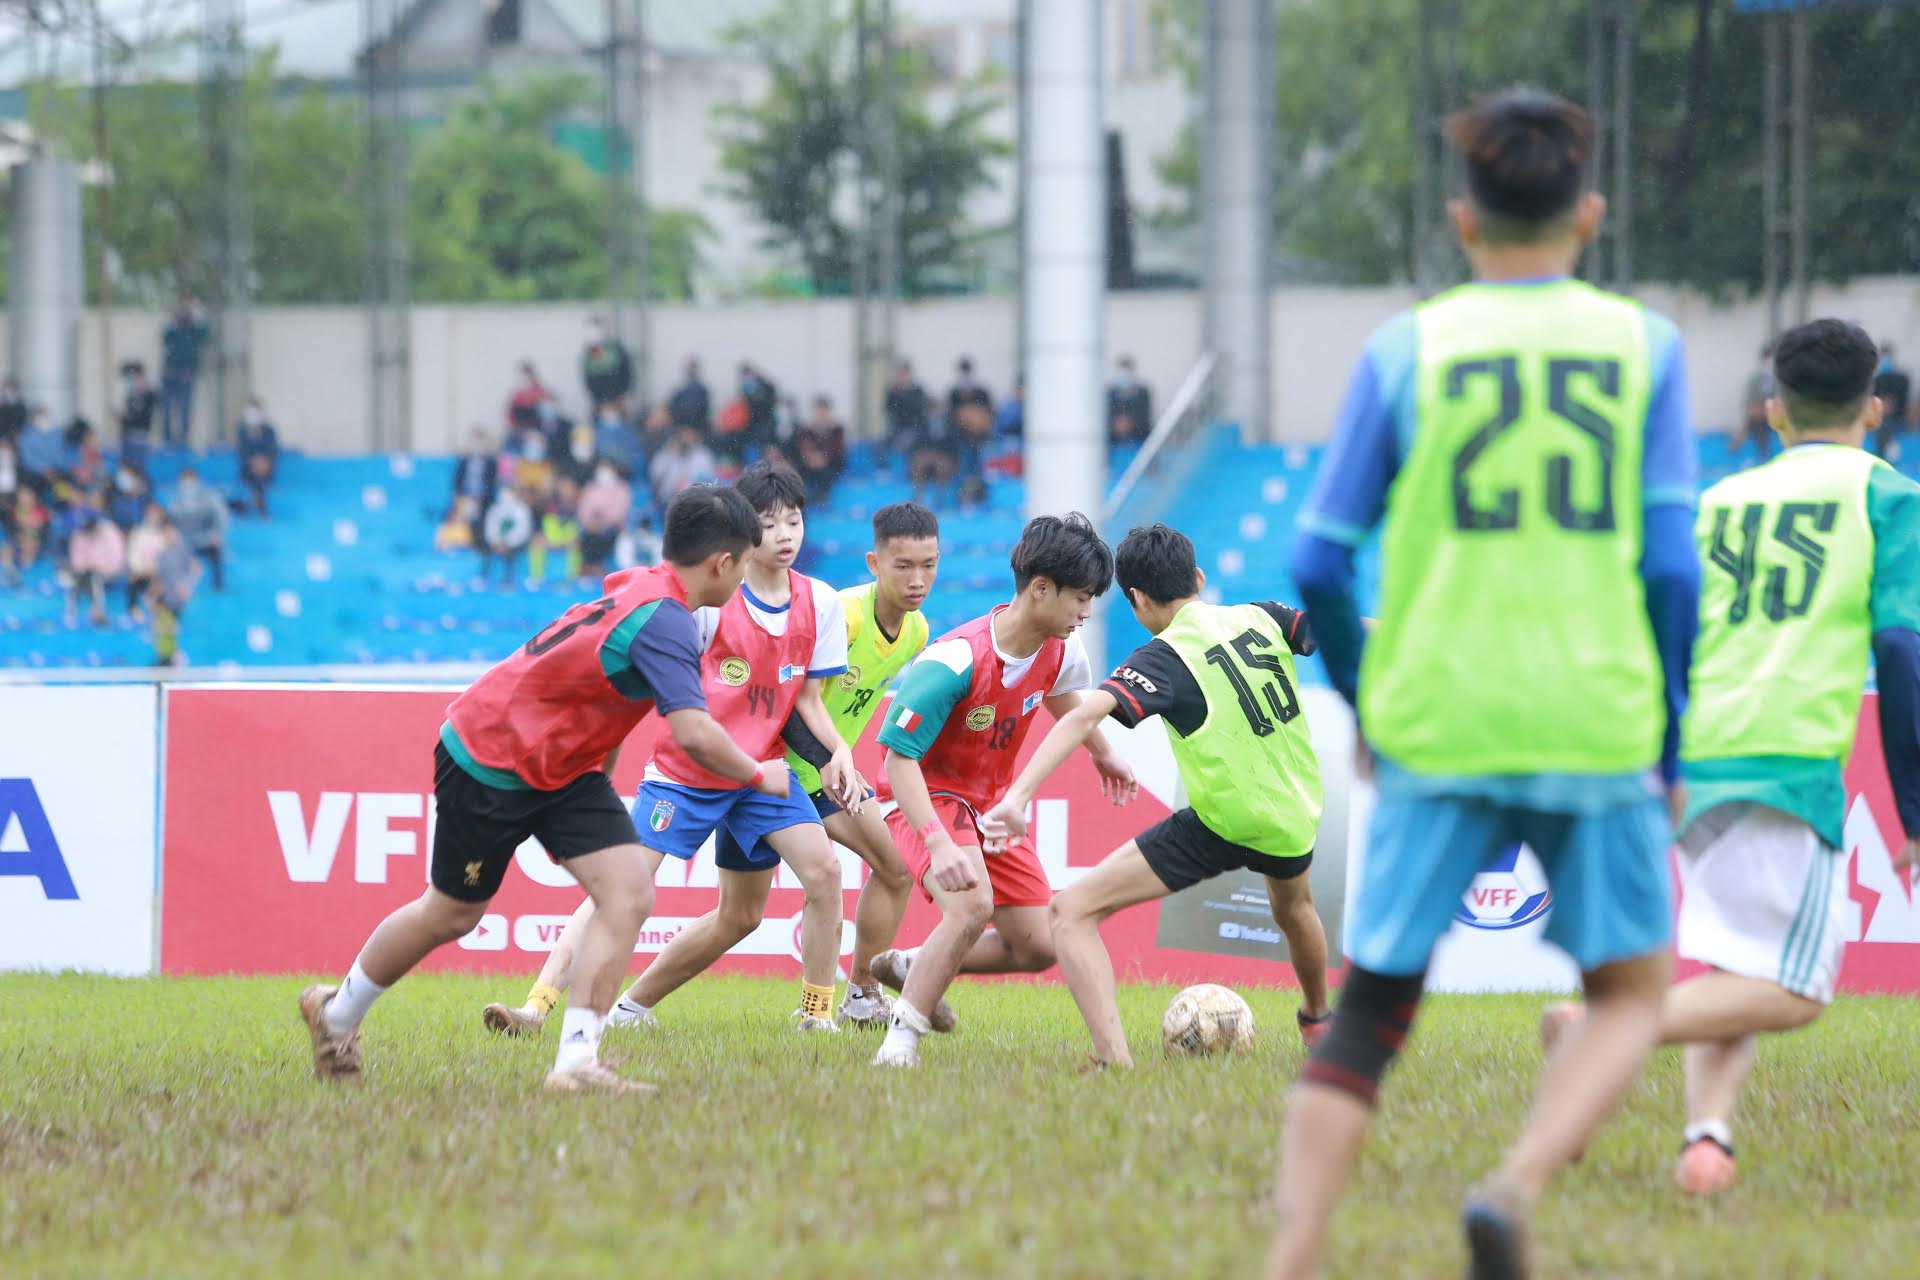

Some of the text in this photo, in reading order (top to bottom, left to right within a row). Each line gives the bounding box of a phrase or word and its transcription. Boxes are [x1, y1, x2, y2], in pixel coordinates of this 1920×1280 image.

[1446, 356, 1621, 530] 25
[1710, 503, 1839, 625] 45
[746, 684, 776, 719] 44
[1204, 627, 1301, 737] 15
[988, 716, 1018, 750] 18
[266, 791, 437, 884] VF
[1472, 888, 1518, 906] VFF
